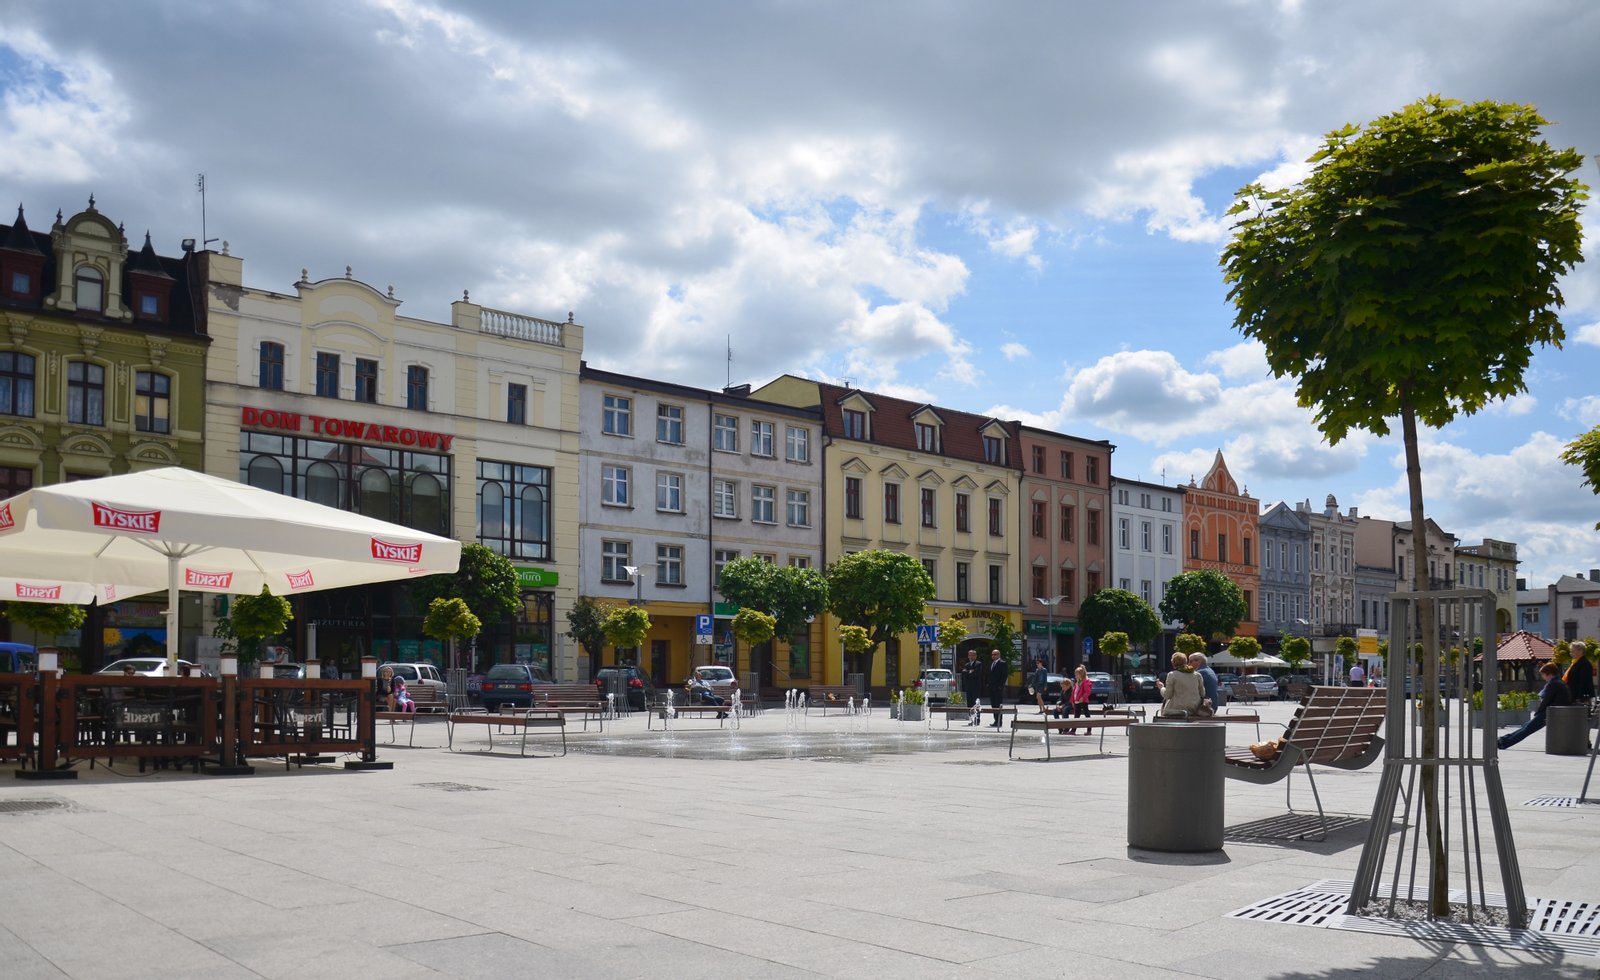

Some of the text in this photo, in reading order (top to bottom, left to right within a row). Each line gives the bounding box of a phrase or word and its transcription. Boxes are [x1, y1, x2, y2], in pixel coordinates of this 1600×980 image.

[241, 406, 456, 452] DOM TOWAROWY
[97, 508, 156, 530] TYSKIE
[374, 541, 419, 561] TYSKIE
[700, 616, 709, 629] P
